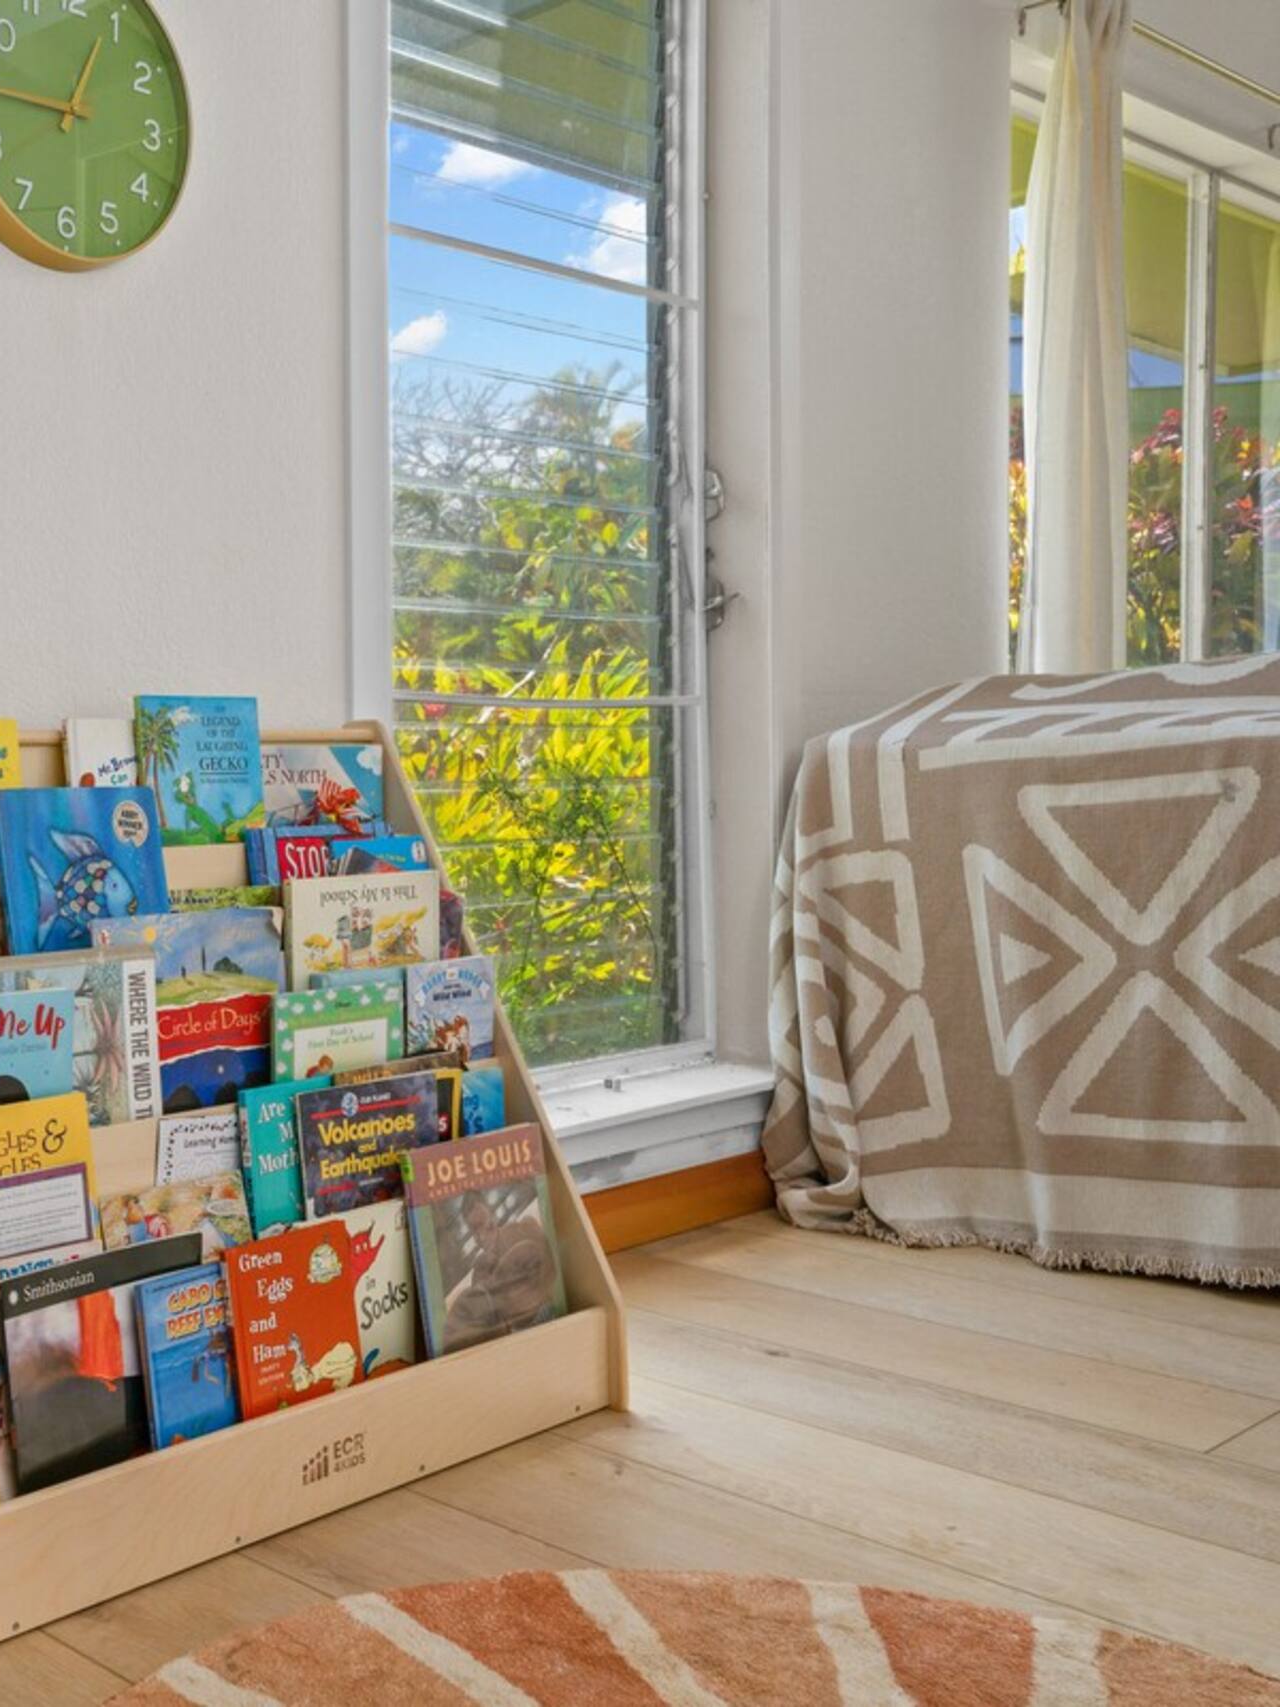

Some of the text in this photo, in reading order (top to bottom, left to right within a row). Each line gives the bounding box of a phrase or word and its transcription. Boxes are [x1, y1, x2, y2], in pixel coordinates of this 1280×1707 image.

[110, 11, 120, 43] 1
[133, 61, 152, 95] 2
[142, 119, 161, 152] 3
[15, 178, 33, 210] 7
[130, 172, 149, 203] 4
[57, 206, 76, 238] 6
[100, 201, 119, 234] 5
[199, 756, 249, 771] GECKO
[281, 769, 328, 784] NORTH
[321, 887, 358, 908] School
[361, 884, 378, 903] My
[395, 885, 418, 900] This
[128, 970, 149, 1027] WHERE
[34, 1003, 66, 1050] Up
[158, 1007, 262, 1040] Circle of Days
[131, 1031, 150, 1060] THE
[133, 1063, 153, 1105] WILD
[257, 1102, 286, 1124] Are
[42, 1118, 68, 1154] &
[279, 1122, 295, 1144] M
[318, 1113, 417, 1146] Volcanoes
[358, 1140, 377, 1153] and
[320, 1152, 403, 1181] Earthquak
[428, 1139, 532, 1187] JOE LOUIS
[238, 1251, 283, 1273] Green
[23, 1270, 95, 1301] Smithsonian
[256, 1277, 293, 1304] Eggs
[366, 1276, 376, 1291] in
[360, 1280, 409, 1331] Socks
[249, 1312, 277, 1334] and
[253, 1344, 287, 1364] Ham
[333, 1433, 364, 1460] ECR
